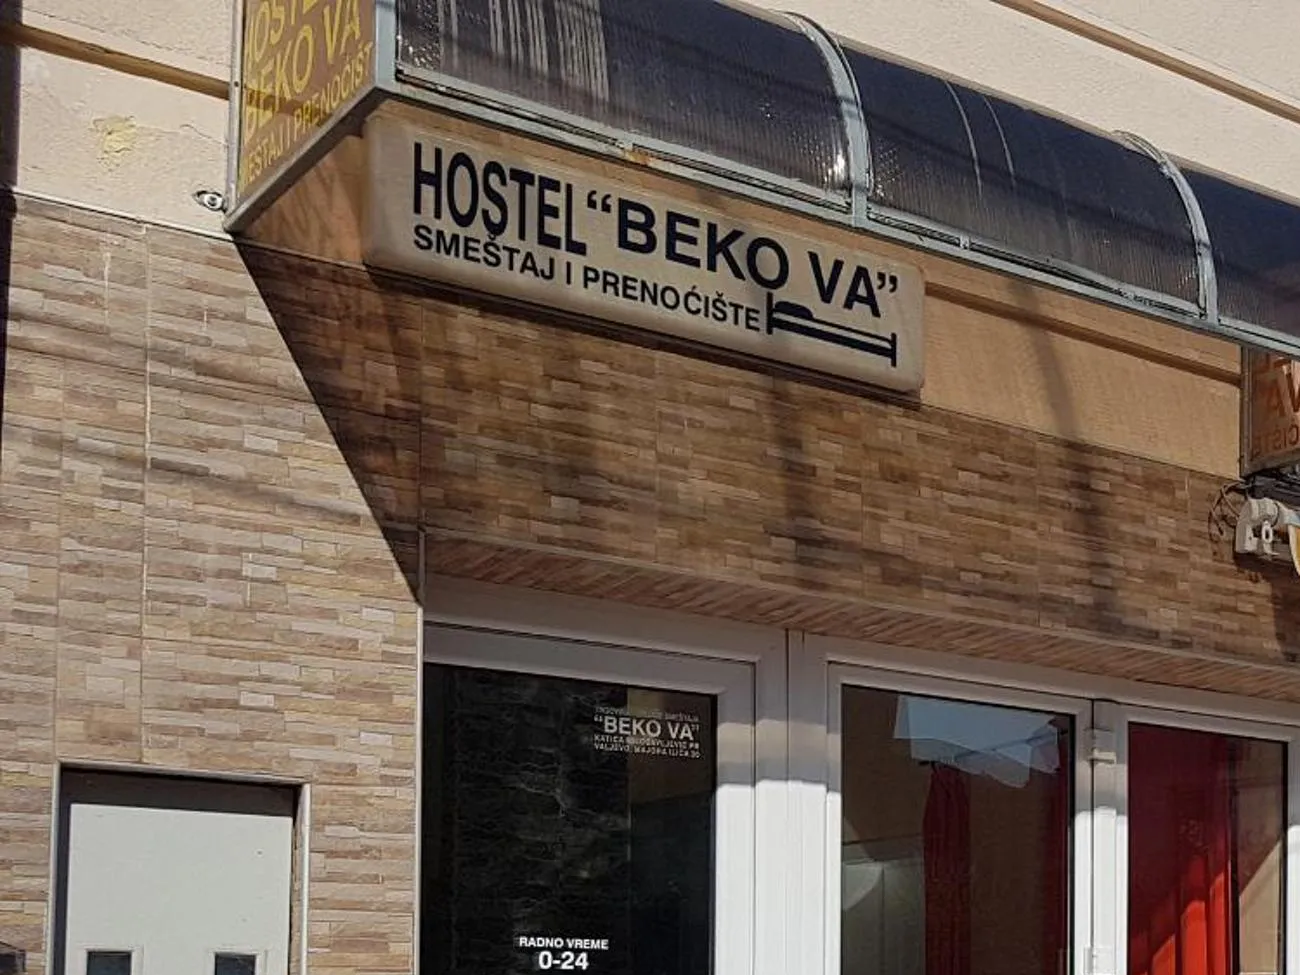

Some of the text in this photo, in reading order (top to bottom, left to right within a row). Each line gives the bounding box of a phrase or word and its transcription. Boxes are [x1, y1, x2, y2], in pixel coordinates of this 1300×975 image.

[294, 41, 374, 141] PRENOĆIŠT
[414, 142, 586, 256] HOSTEL
[414, 225, 760, 332] SMEŠTAJ I PRENOĆIŠTE
[519, 936, 609, 950] RADNO VREME
[538, 950, 589, 970] 0-24
